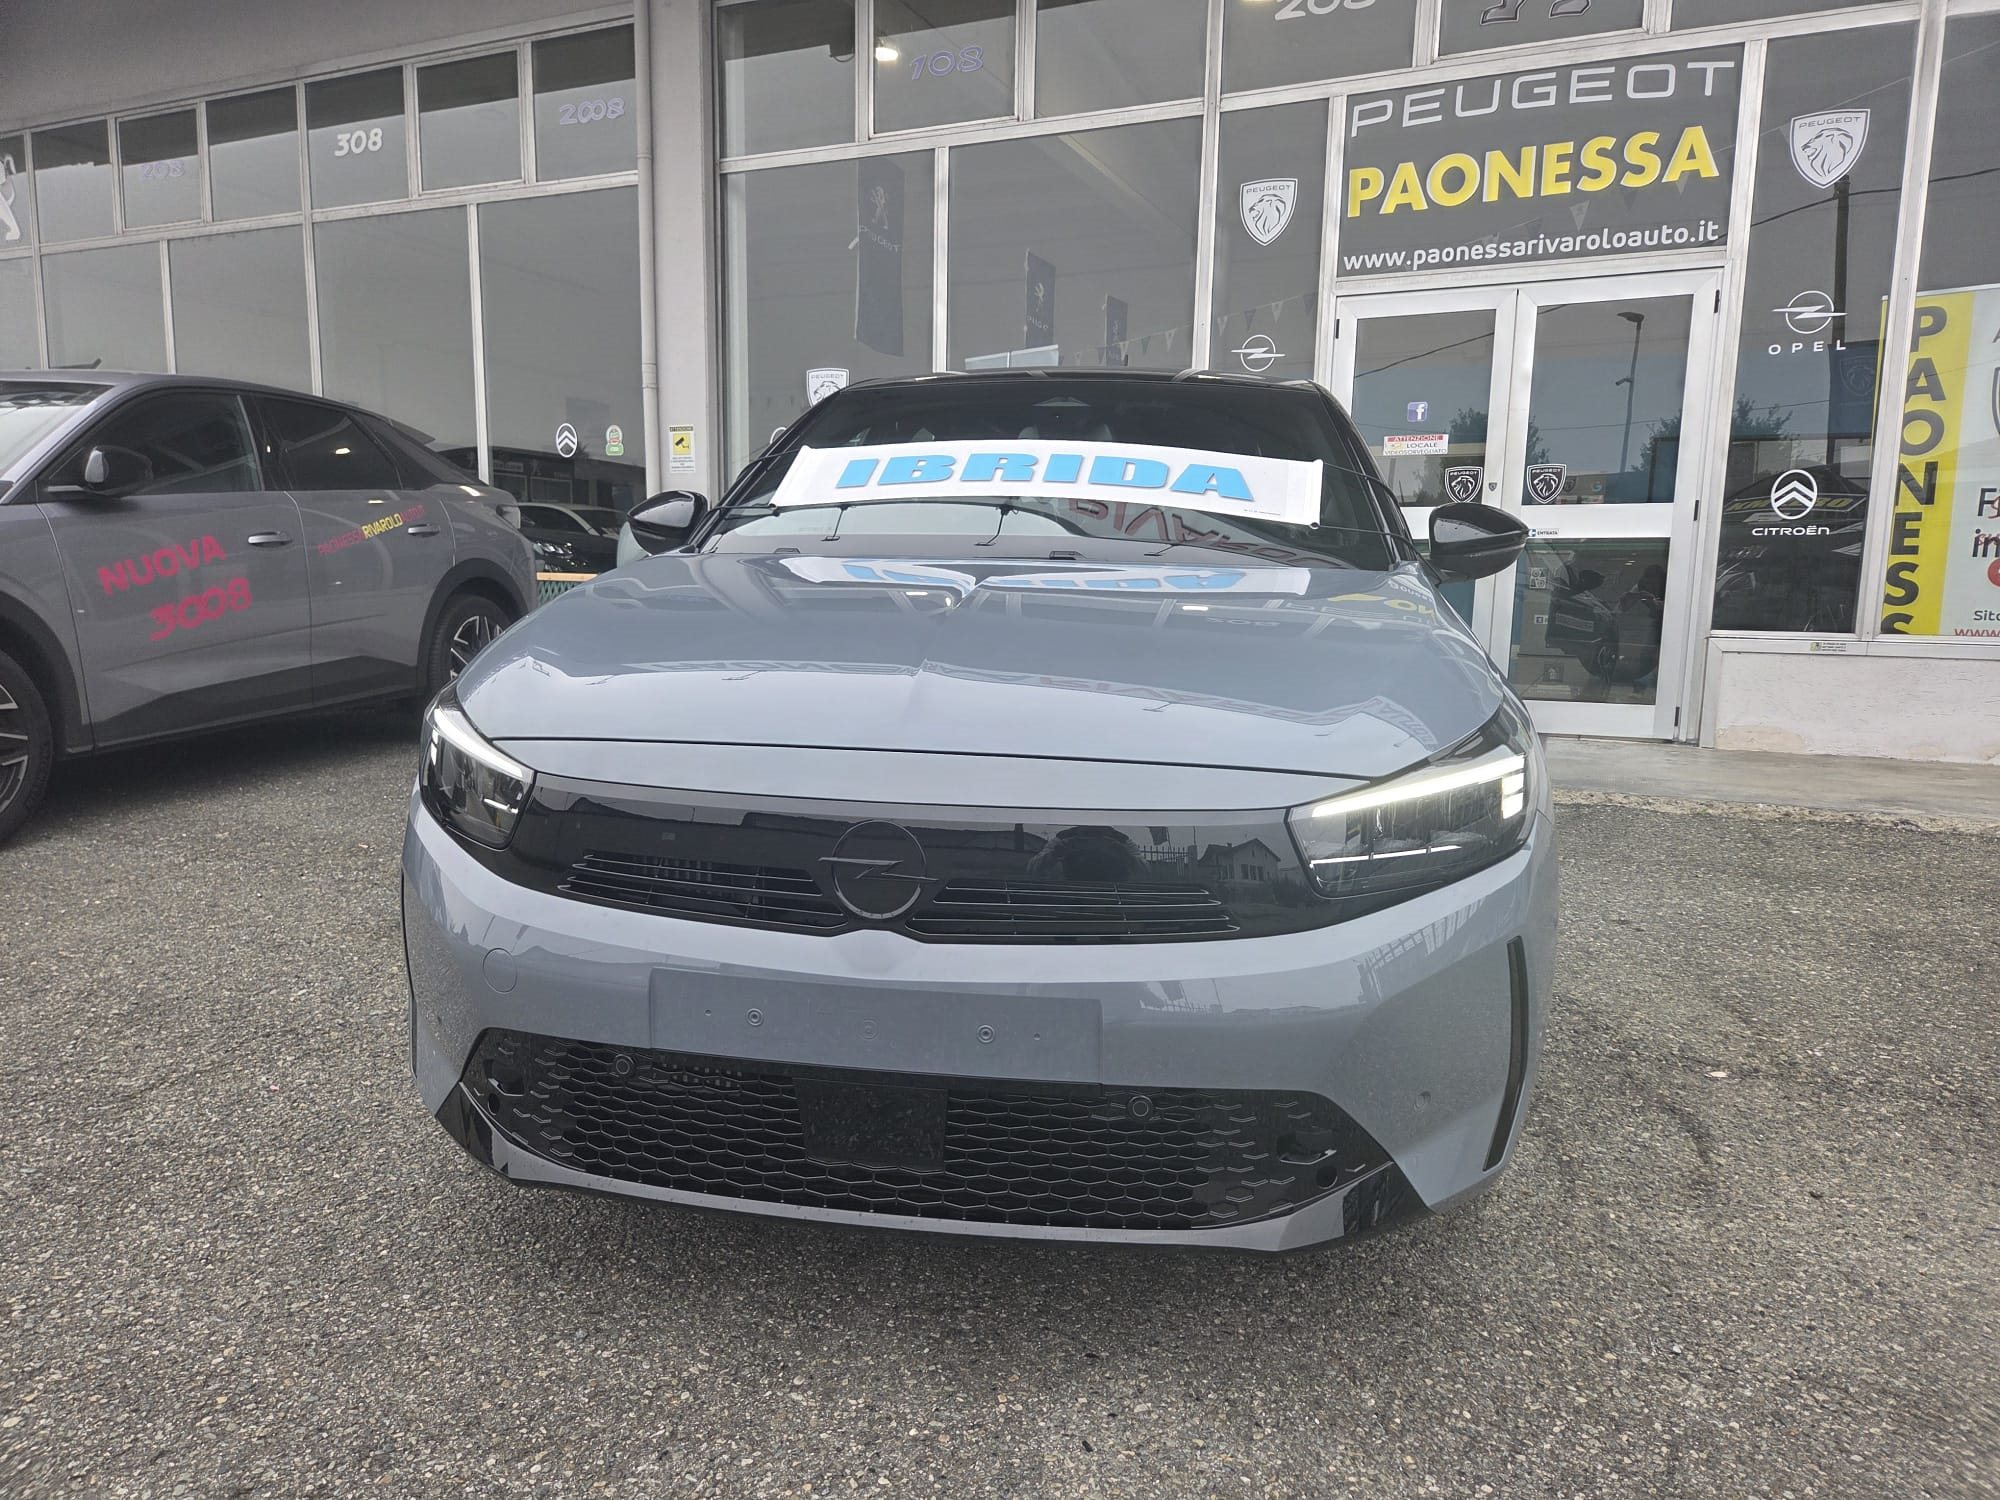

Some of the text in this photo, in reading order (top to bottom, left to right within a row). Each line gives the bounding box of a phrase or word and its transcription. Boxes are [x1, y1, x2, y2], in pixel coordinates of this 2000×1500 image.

[1275, 0, 1376, 20] 20
[911, 45, 983, 81] 108
[558, 97, 625, 126] 2008
[1351, 61, 1735, 137] PEUGEOT
[1799, 116, 1861, 128] PEUGEOT
[334, 127, 383, 157] 308
[1347, 125, 1720, 218] PAONESSA
[1246, 184, 1291, 194] PEUGEOT
[1343, 220, 1720, 271] www.paonessarivaroloauto.it
[1768, 339, 1847, 355] OPEL
[835, 453, 1256, 502] IBRIDA
[1751, 525, 1830, 536] CITROËN
[97, 535, 226, 597] NUOVA
[149, 577, 253, 642] 3008
